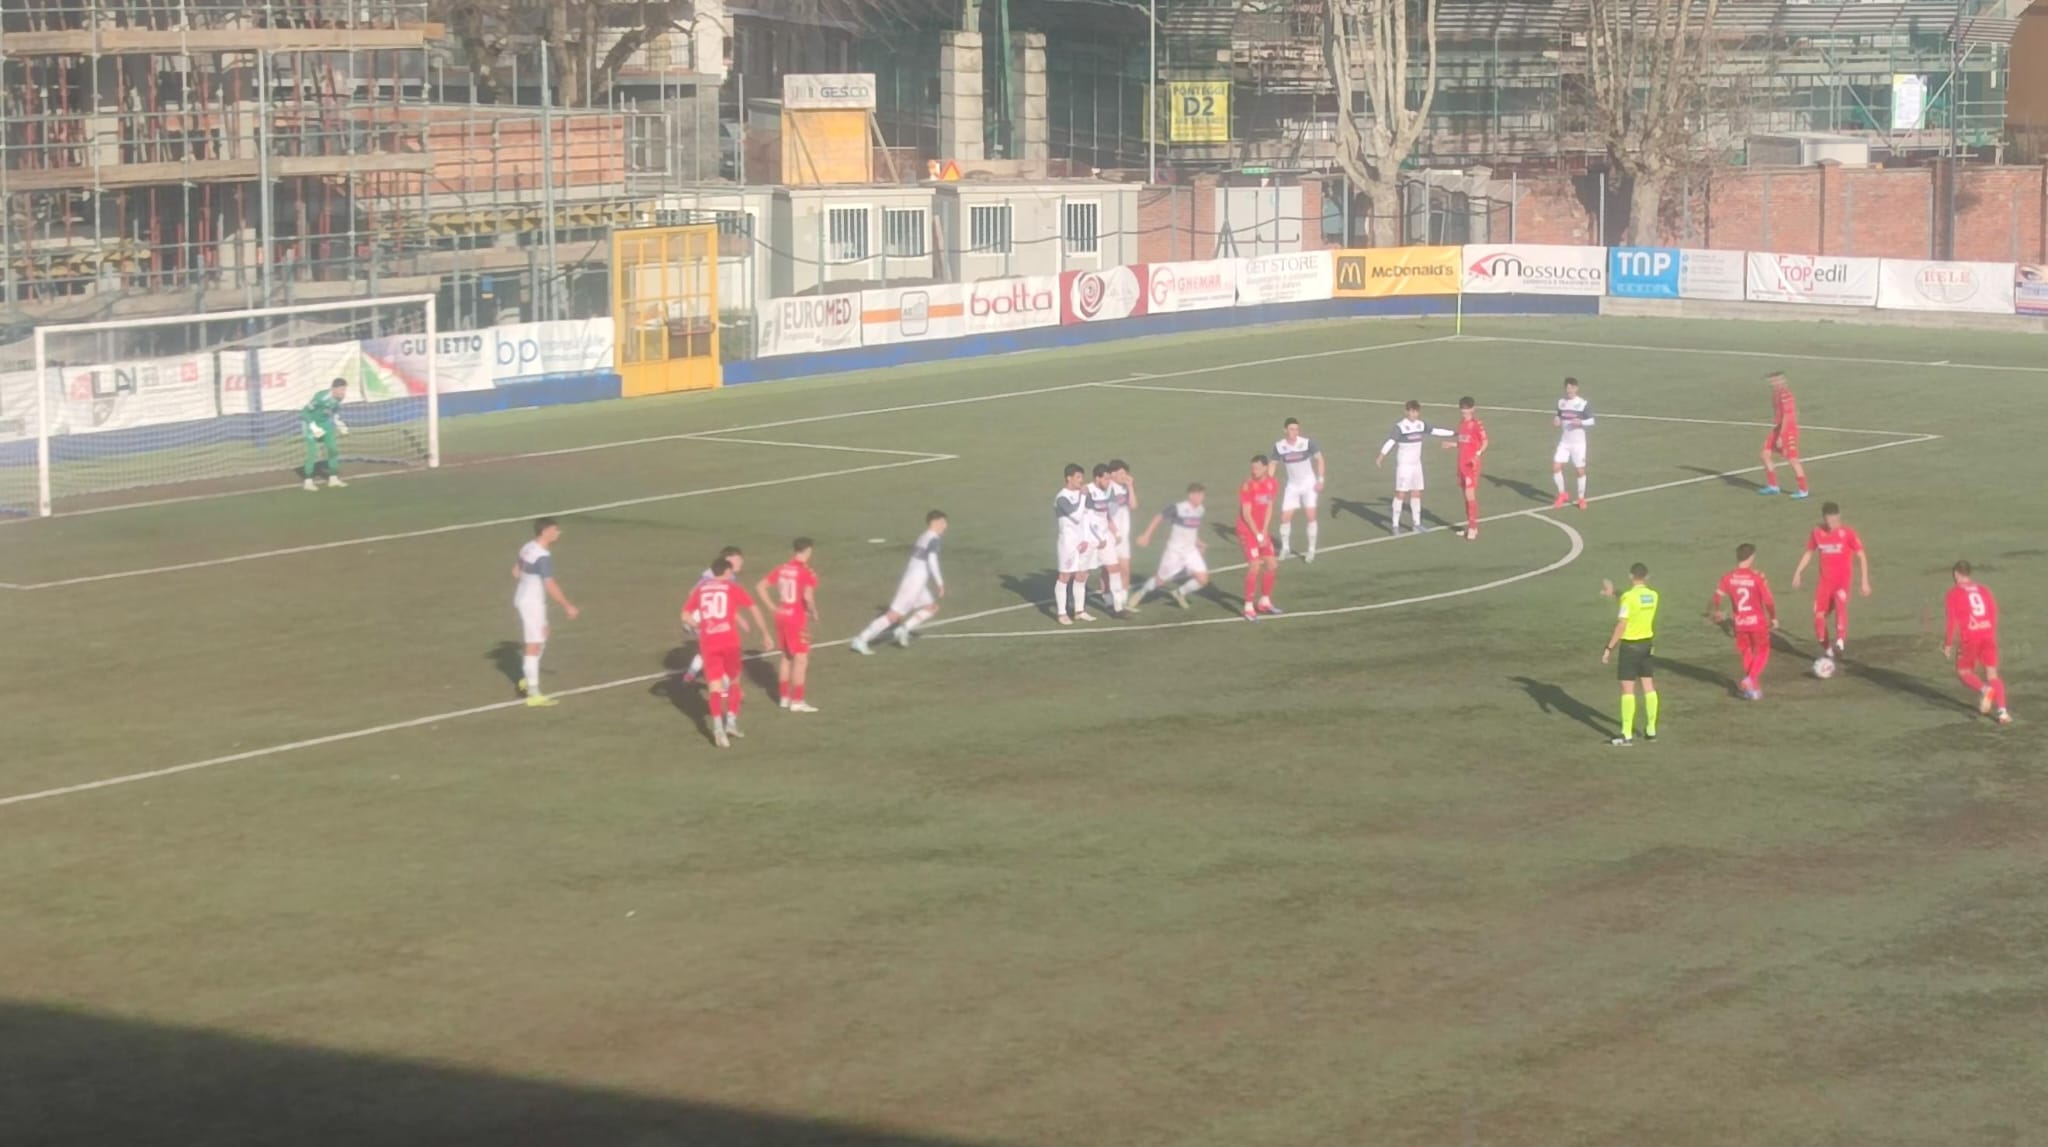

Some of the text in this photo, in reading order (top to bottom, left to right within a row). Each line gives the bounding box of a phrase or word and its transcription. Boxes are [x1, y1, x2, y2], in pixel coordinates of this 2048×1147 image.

[820, 86, 869, 98] GESCO
[1183, 96, 1215, 117] D2
[1271, 255, 1319, 272] STORE
[1371, 263, 1454, 279] McDonald's
[970, 282, 1053, 317] botta
[783, 297, 852, 330] EUROMED
[401, 335, 482, 356] GUIETTO
[495, 329, 539, 374] bp
[700, 591, 728, 620] 50
[1736, 587, 1752, 612] 2
[1968, 592, 1986, 617] 9
